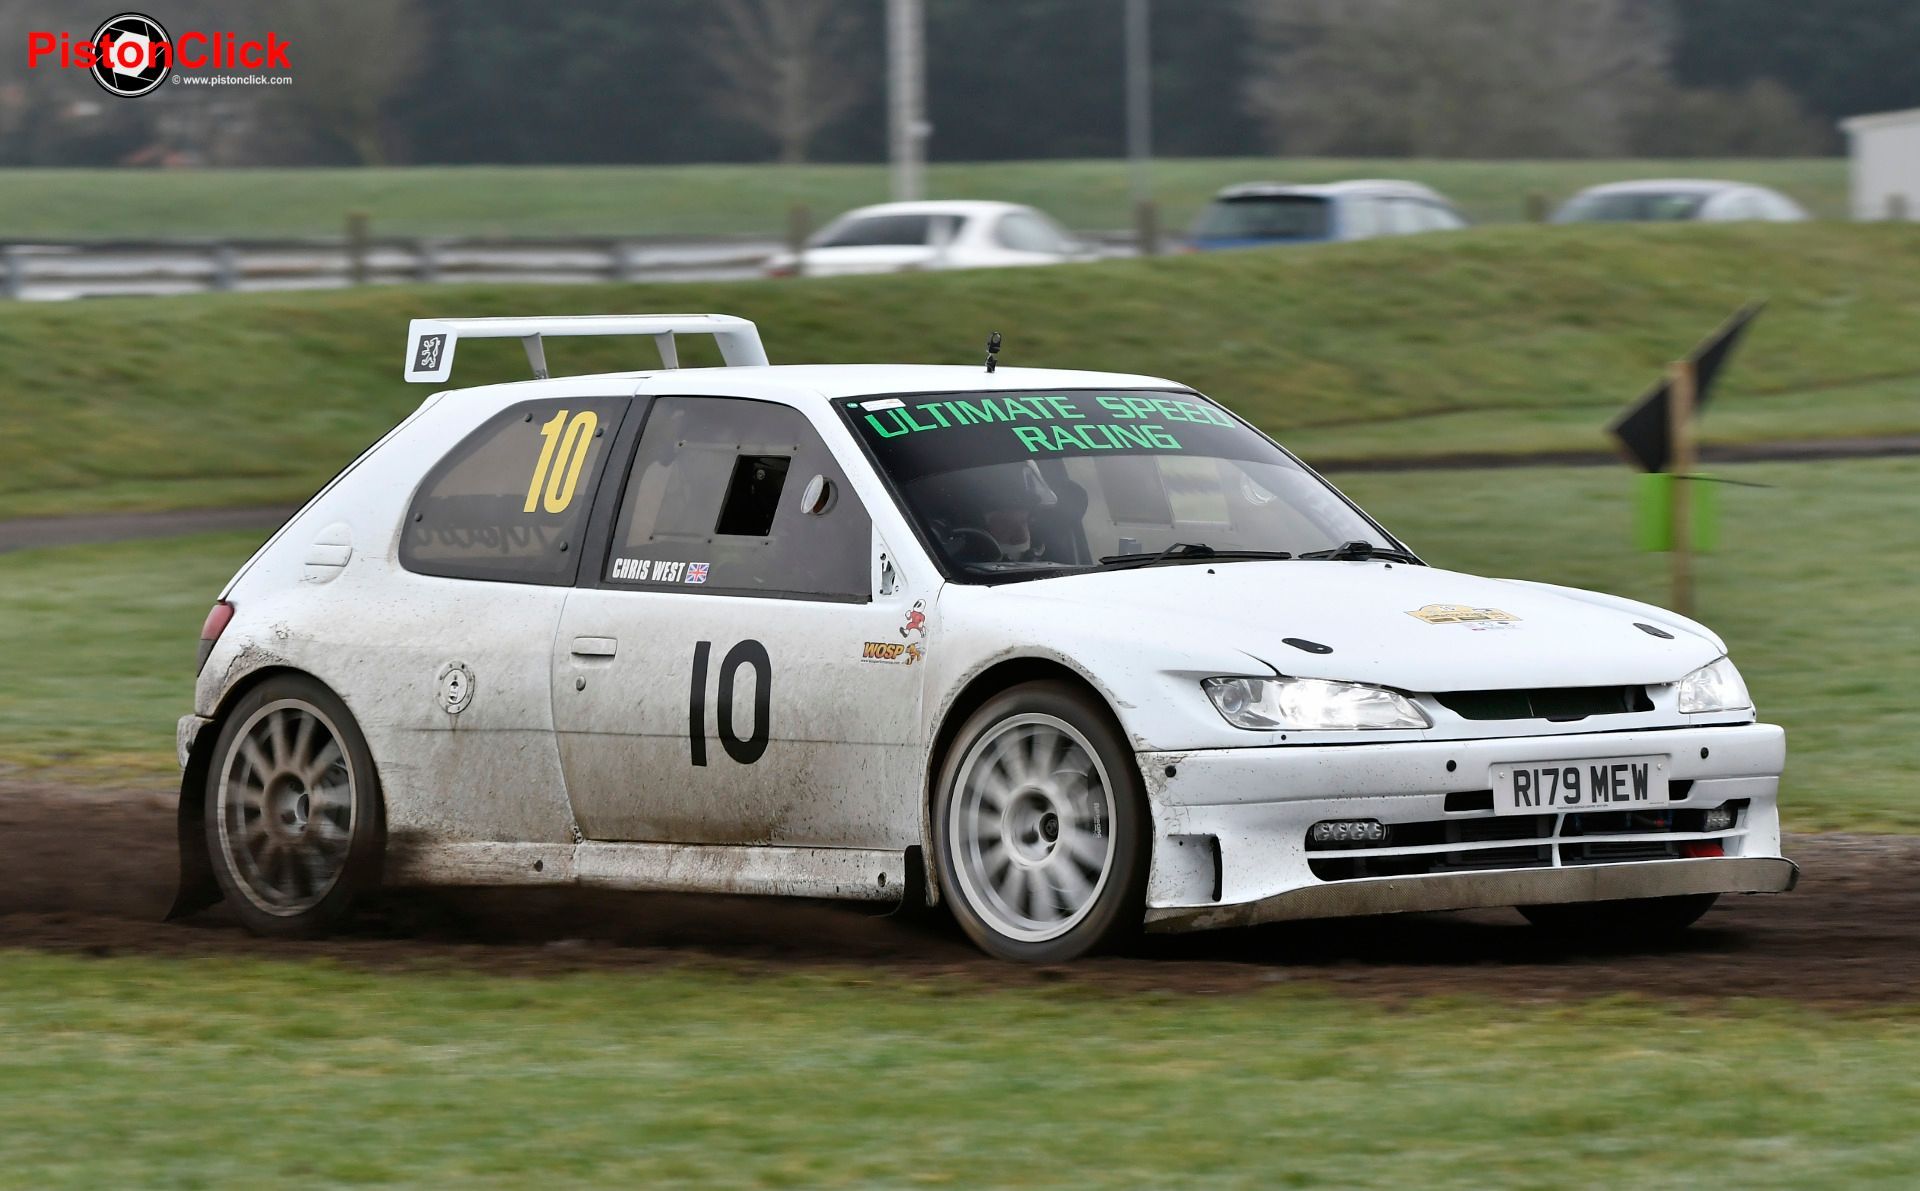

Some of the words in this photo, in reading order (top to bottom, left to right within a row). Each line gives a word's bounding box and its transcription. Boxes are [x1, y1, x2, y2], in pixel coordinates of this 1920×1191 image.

[864, 396, 1086, 438] ULTIMATE
[1096, 396, 1236, 428] SPEED
[1012, 424, 1183, 453] RACING
[523, 410, 598, 513] 10
[612, 558, 651, 580] CHRIS
[652, 560, 686, 582] WEST
[863, 641, 905, 660] WOSP
[689, 639, 772, 767] 10
[1513, 767, 1581, 807] R179
[1590, 763, 1648, 803] MEW
